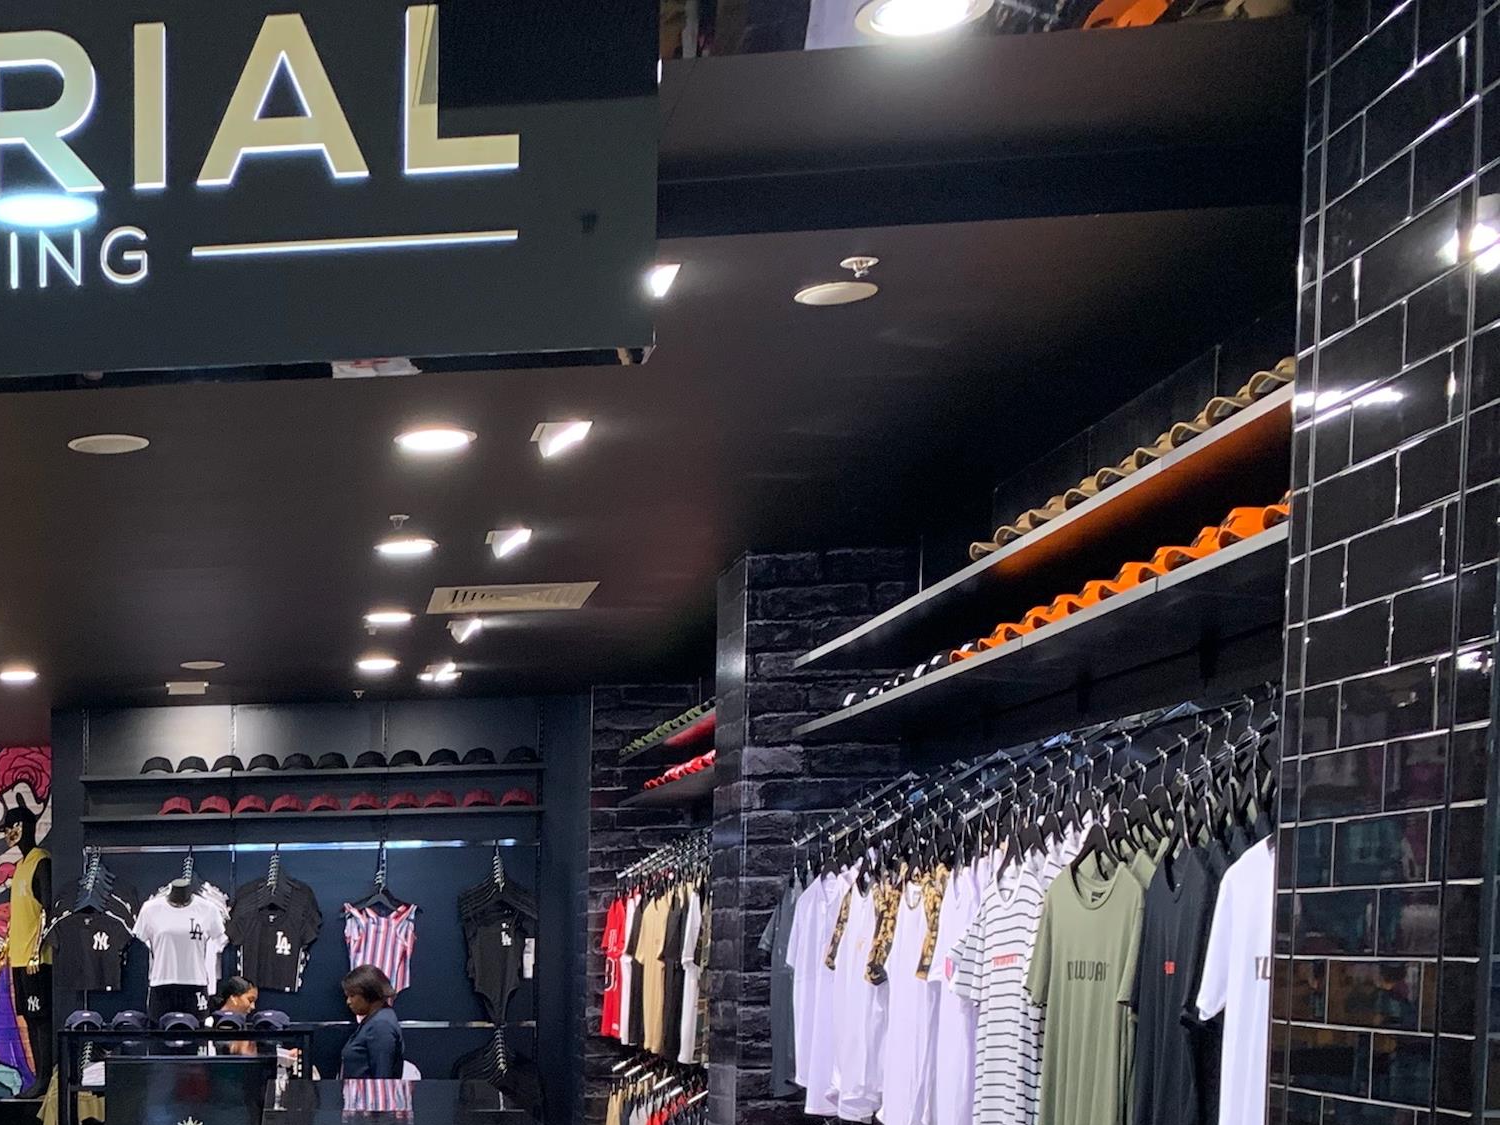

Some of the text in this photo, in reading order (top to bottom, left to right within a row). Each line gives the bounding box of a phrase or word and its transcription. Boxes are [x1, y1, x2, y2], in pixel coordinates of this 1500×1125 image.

[189, 918, 204, 940] LA
[92, 931, 111, 951] NY
[275, 931, 292, 956] LA
